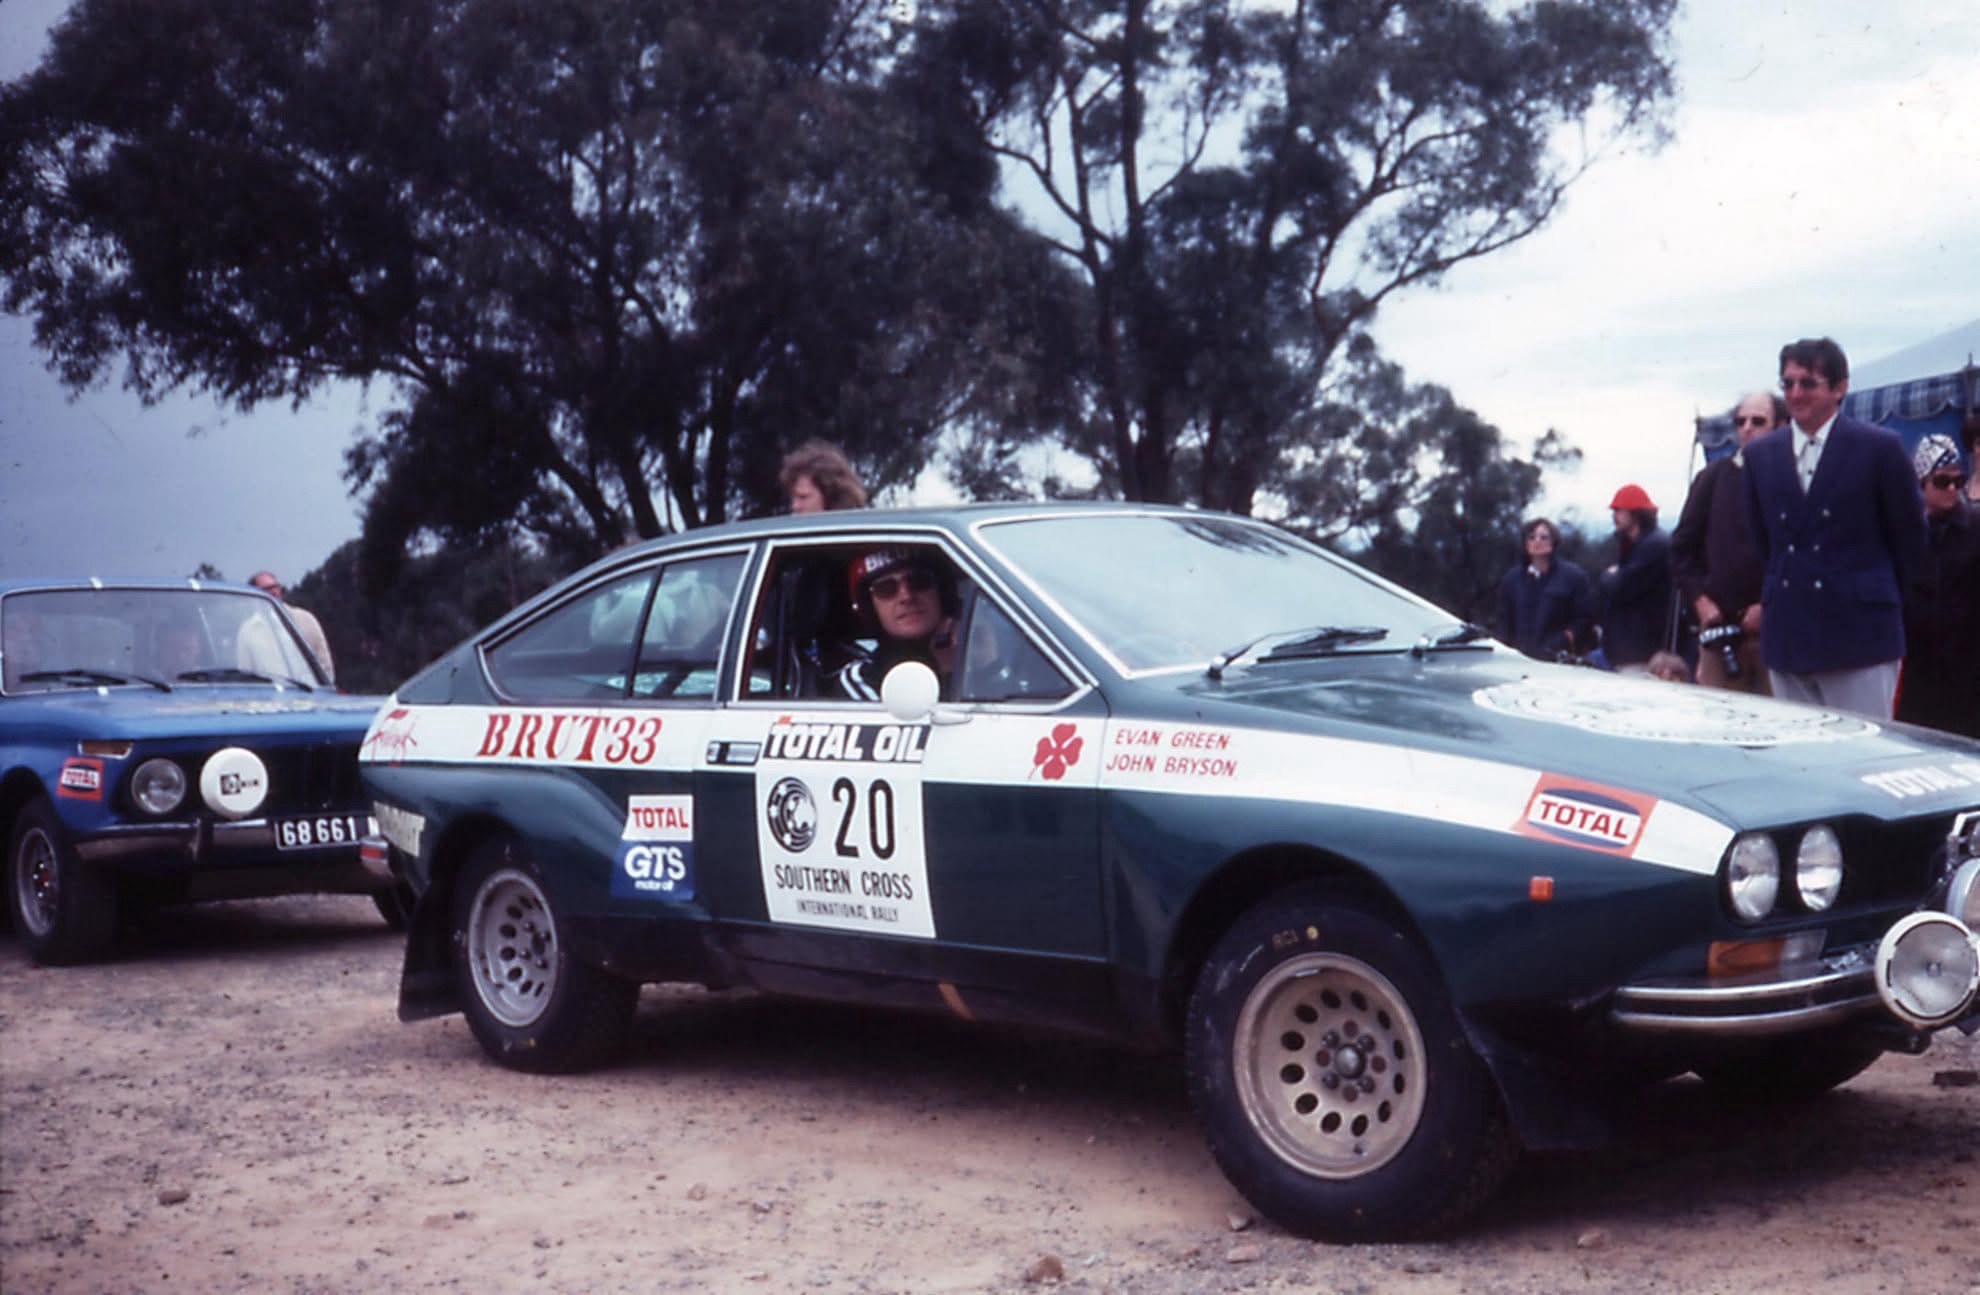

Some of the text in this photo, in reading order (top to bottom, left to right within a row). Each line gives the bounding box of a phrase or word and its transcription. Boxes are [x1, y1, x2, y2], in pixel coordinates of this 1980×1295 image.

[769, 723, 926, 762] TOTAL OIL
[1115, 729, 1230, 750] EVAN GREEN
[1106, 754, 1238, 777] JOHN BRYSON
[632, 807, 689, 829] TOTAL
[832, 777, 895, 860] 20
[1541, 800, 1629, 839] TOTAL
[624, 846, 686, 880] GTS
[775, 864, 914, 901] SOUTHERN CROSS
[797, 899, 899, 922] INTERNATIONAL RALLY
